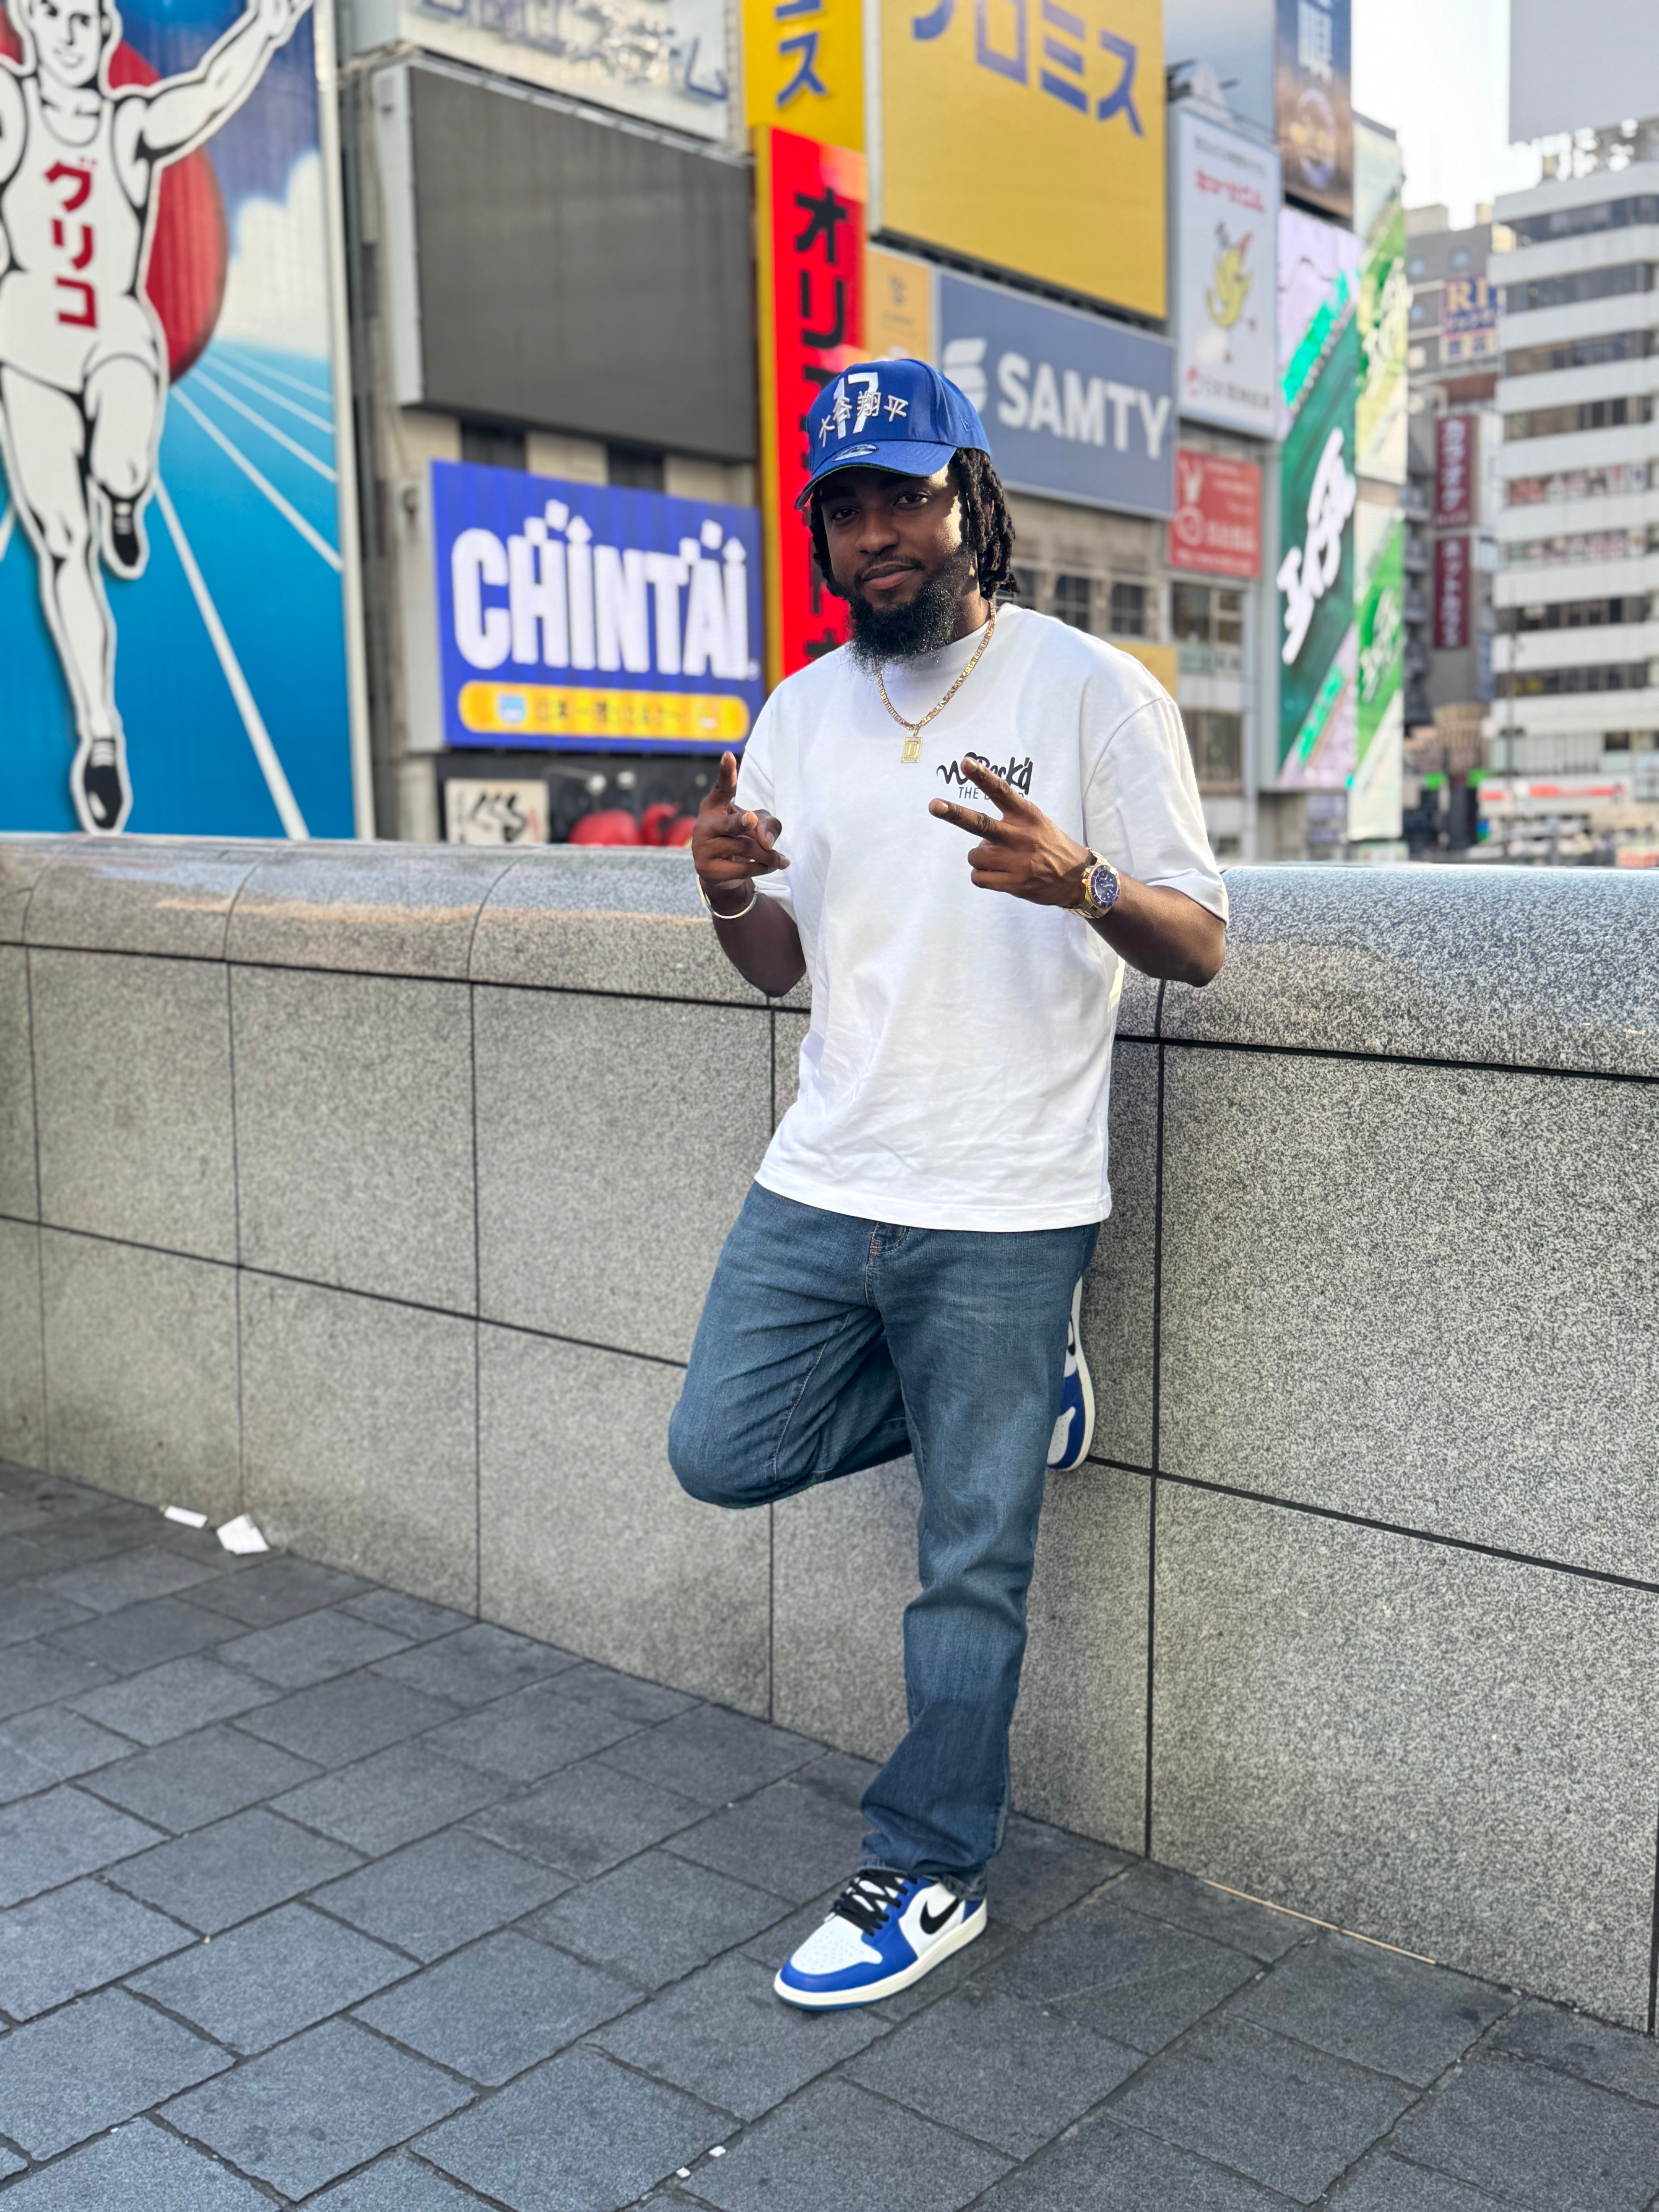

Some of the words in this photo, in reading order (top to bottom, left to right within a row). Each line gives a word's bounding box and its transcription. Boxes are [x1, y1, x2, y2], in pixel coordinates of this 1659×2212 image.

[44, 156, 98, 330] グリコ
[818, 390, 908, 448] 大谷翔平
[833, 372, 879, 440] 17
[997, 351, 1171, 460] SAMTY
[451, 498, 750, 680] CHINTAI
[959, 786, 979, 799] THE
